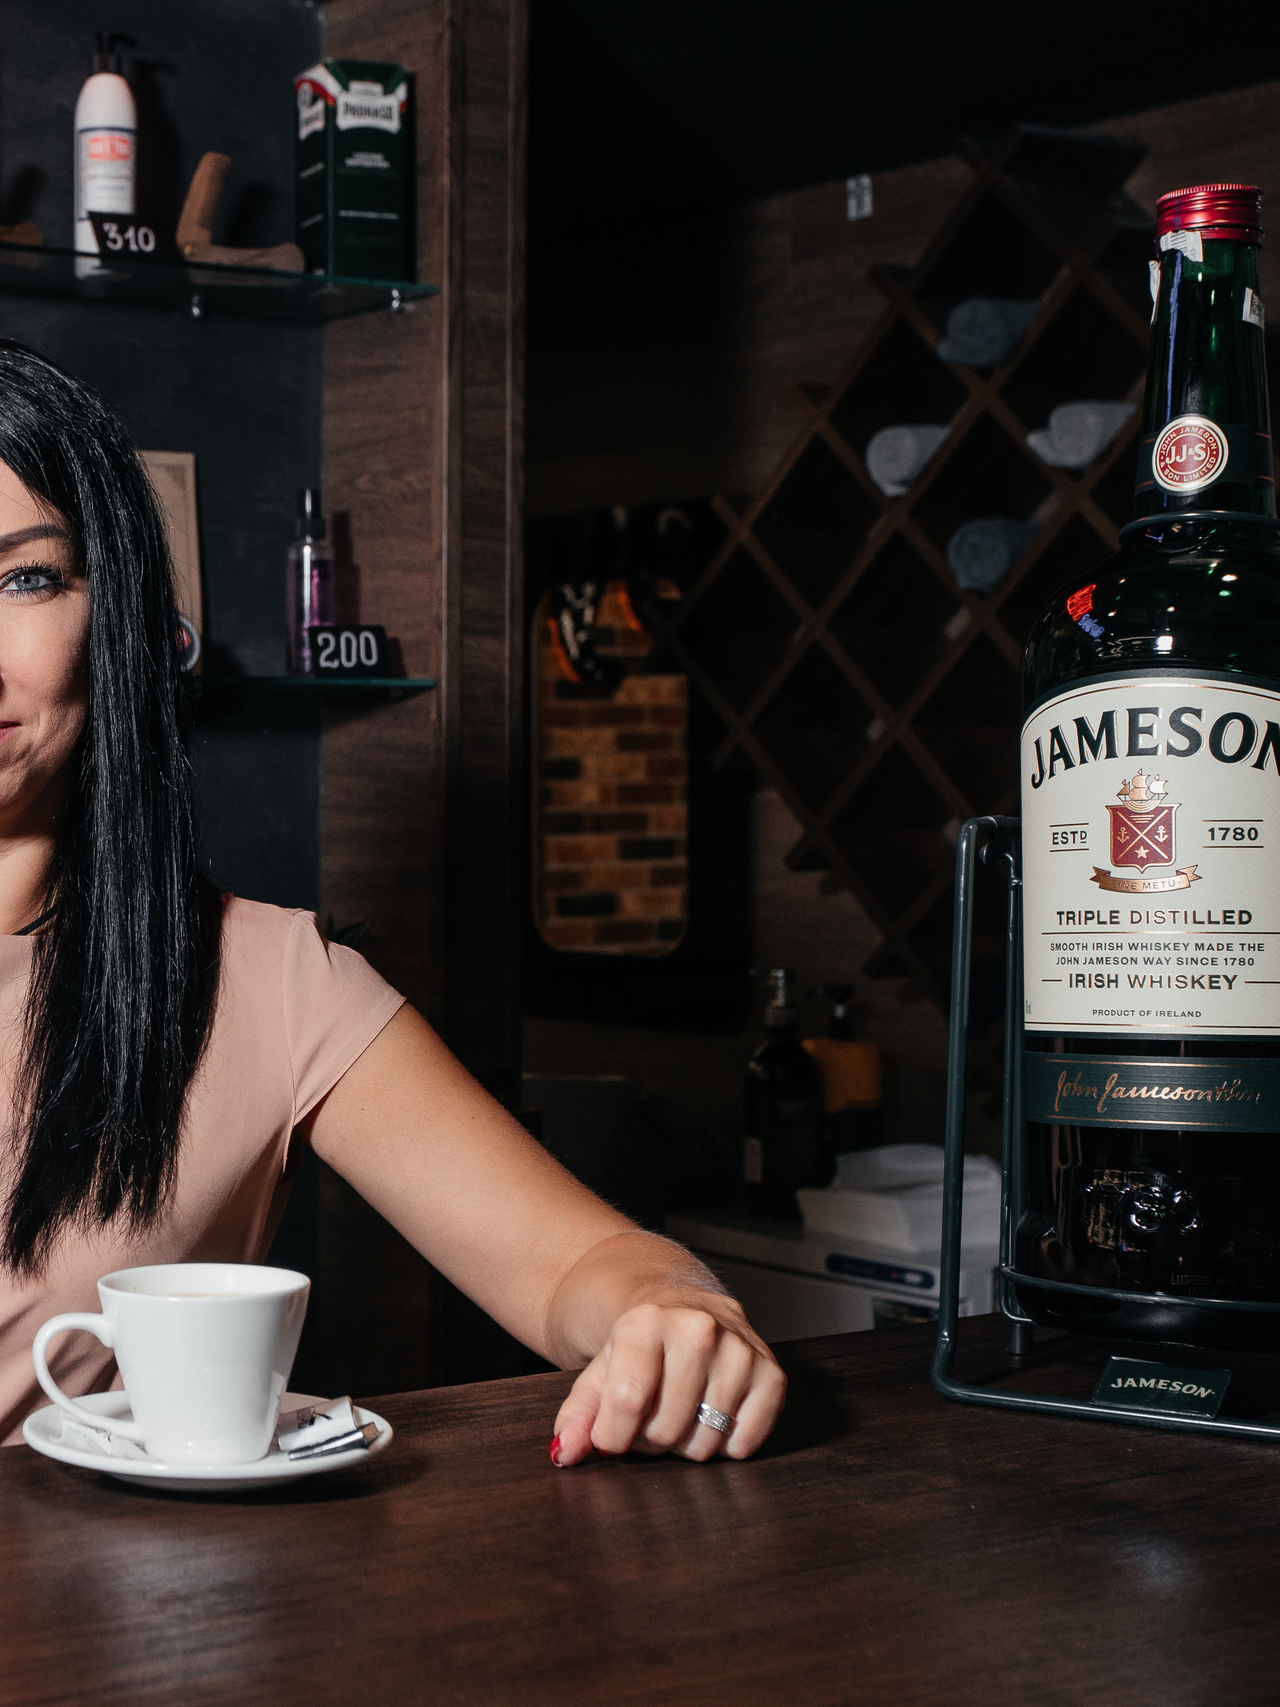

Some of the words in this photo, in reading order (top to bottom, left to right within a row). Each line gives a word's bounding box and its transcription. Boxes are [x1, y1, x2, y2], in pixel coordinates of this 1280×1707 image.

[102, 222, 155, 252] 310
[1161, 432, 1177, 455] JOHN
[1179, 426, 1217, 450] JAMESON
[1165, 443, 1206, 464] JJ&S
[1163, 468, 1180, 481] SON
[1183, 457, 1216, 482] LIMITED
[317, 630, 378, 669] 200
[1208, 827, 1259, 841] 1780
[1110, 881, 1138, 890] SINE
[1142, 880, 1176, 890] METU
[1056, 910, 1121, 926] TRIPLE
[1130, 909, 1253, 926] DISTILLED
[1050, 943, 1088, 952] SMOOTH
[1092, 942, 1123, 951] IRISH
[1128, 942, 1190, 952] WHISKEY
[1194, 942, 1234, 952] MADE
[1239, 943, 1265, 952] THE
[1056, 957, 1080, 966] JOHN
[1082, 957, 1138, 966] JAMESON
[1142, 957, 1172, 966] WAY
[1176, 957, 1219, 967] SINCE
[1223, 957, 1255, 967] 1780
[1069, 974, 1119, 989] IRISH
[1127, 974, 1238, 990] WHISKEY
[1092, 1009, 1135, 1017] PRODUCT
[1139, 1009, 1152, 1017] OF
[1155, 1009, 1202, 1018] IRELAND
[1054, 1070, 1098, 1112] John
[1097, 1072, 1212, 1113] Jameson
[1110, 1377, 1212, 1399] JAMESON
